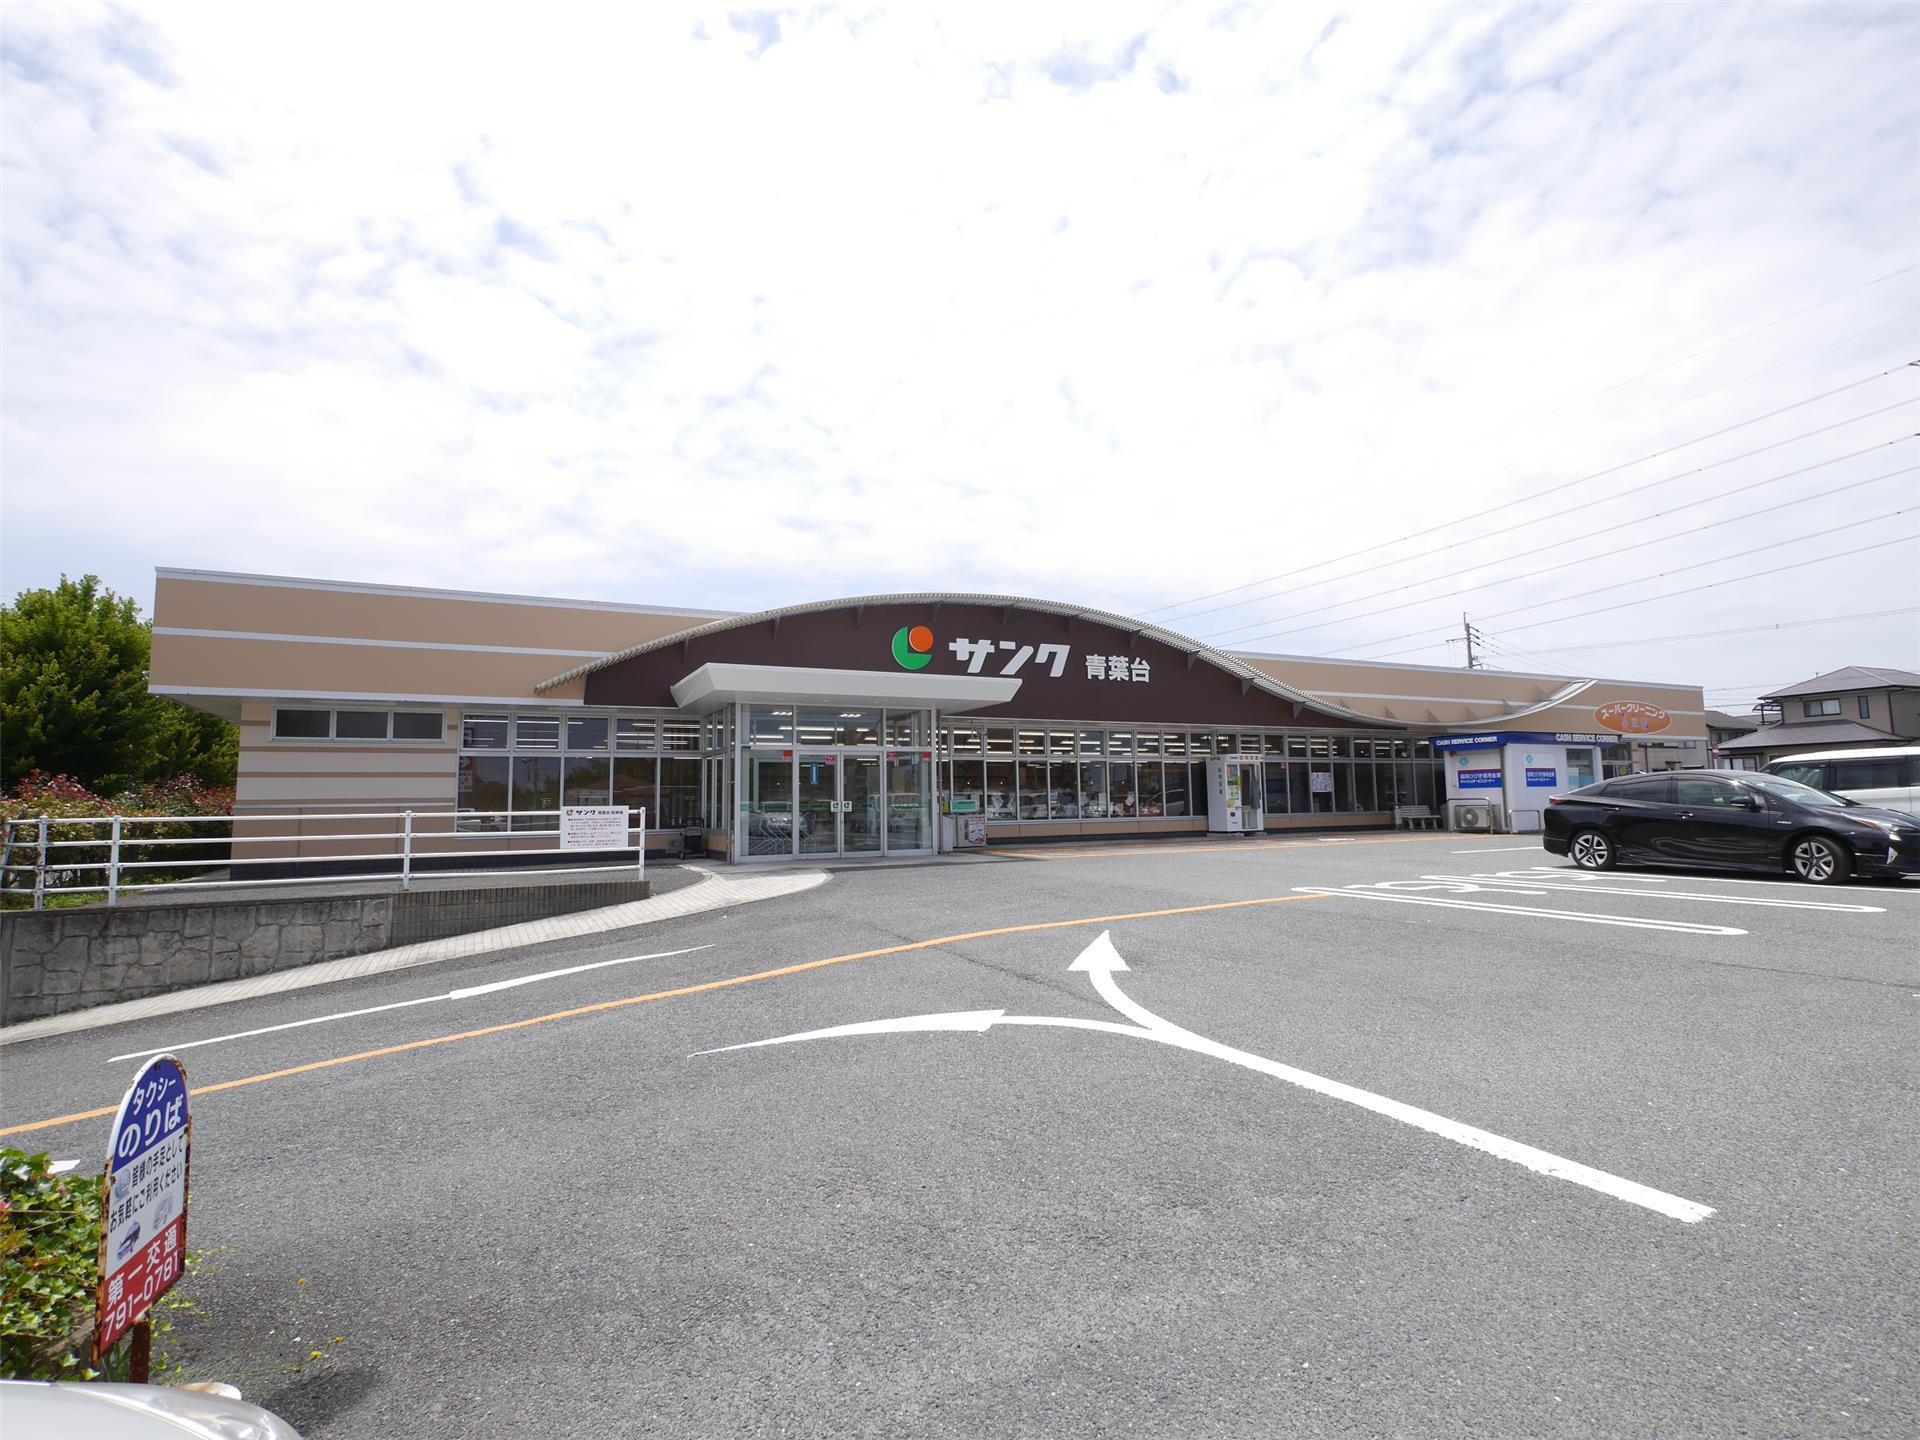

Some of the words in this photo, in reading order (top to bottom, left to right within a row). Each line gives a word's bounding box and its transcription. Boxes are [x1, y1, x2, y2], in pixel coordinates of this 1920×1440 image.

[948, 637, 1071, 678] サンク
[1085, 654, 1152, 683] 青葉台
[1600, 704, 1666, 720] スーパークリーニング
[1474, 736, 1498, 744] CORNER
[1555, 733, 1572, 742] CASH
[1572, 734, 1596, 743] SERVICE
[1596, 735, 1619, 743] CORNER
[133, 1077, 176, 1116] タクシー
[118, 1094, 184, 1158] のりば
[132, 1133, 187, 1188] 皆様の手足として
[110, 1162, 183, 1233] お気軽にご利用ください
[107, 1224, 177, 1311] 第一交通
[105, 1250, 178, 1342] 791-0781
